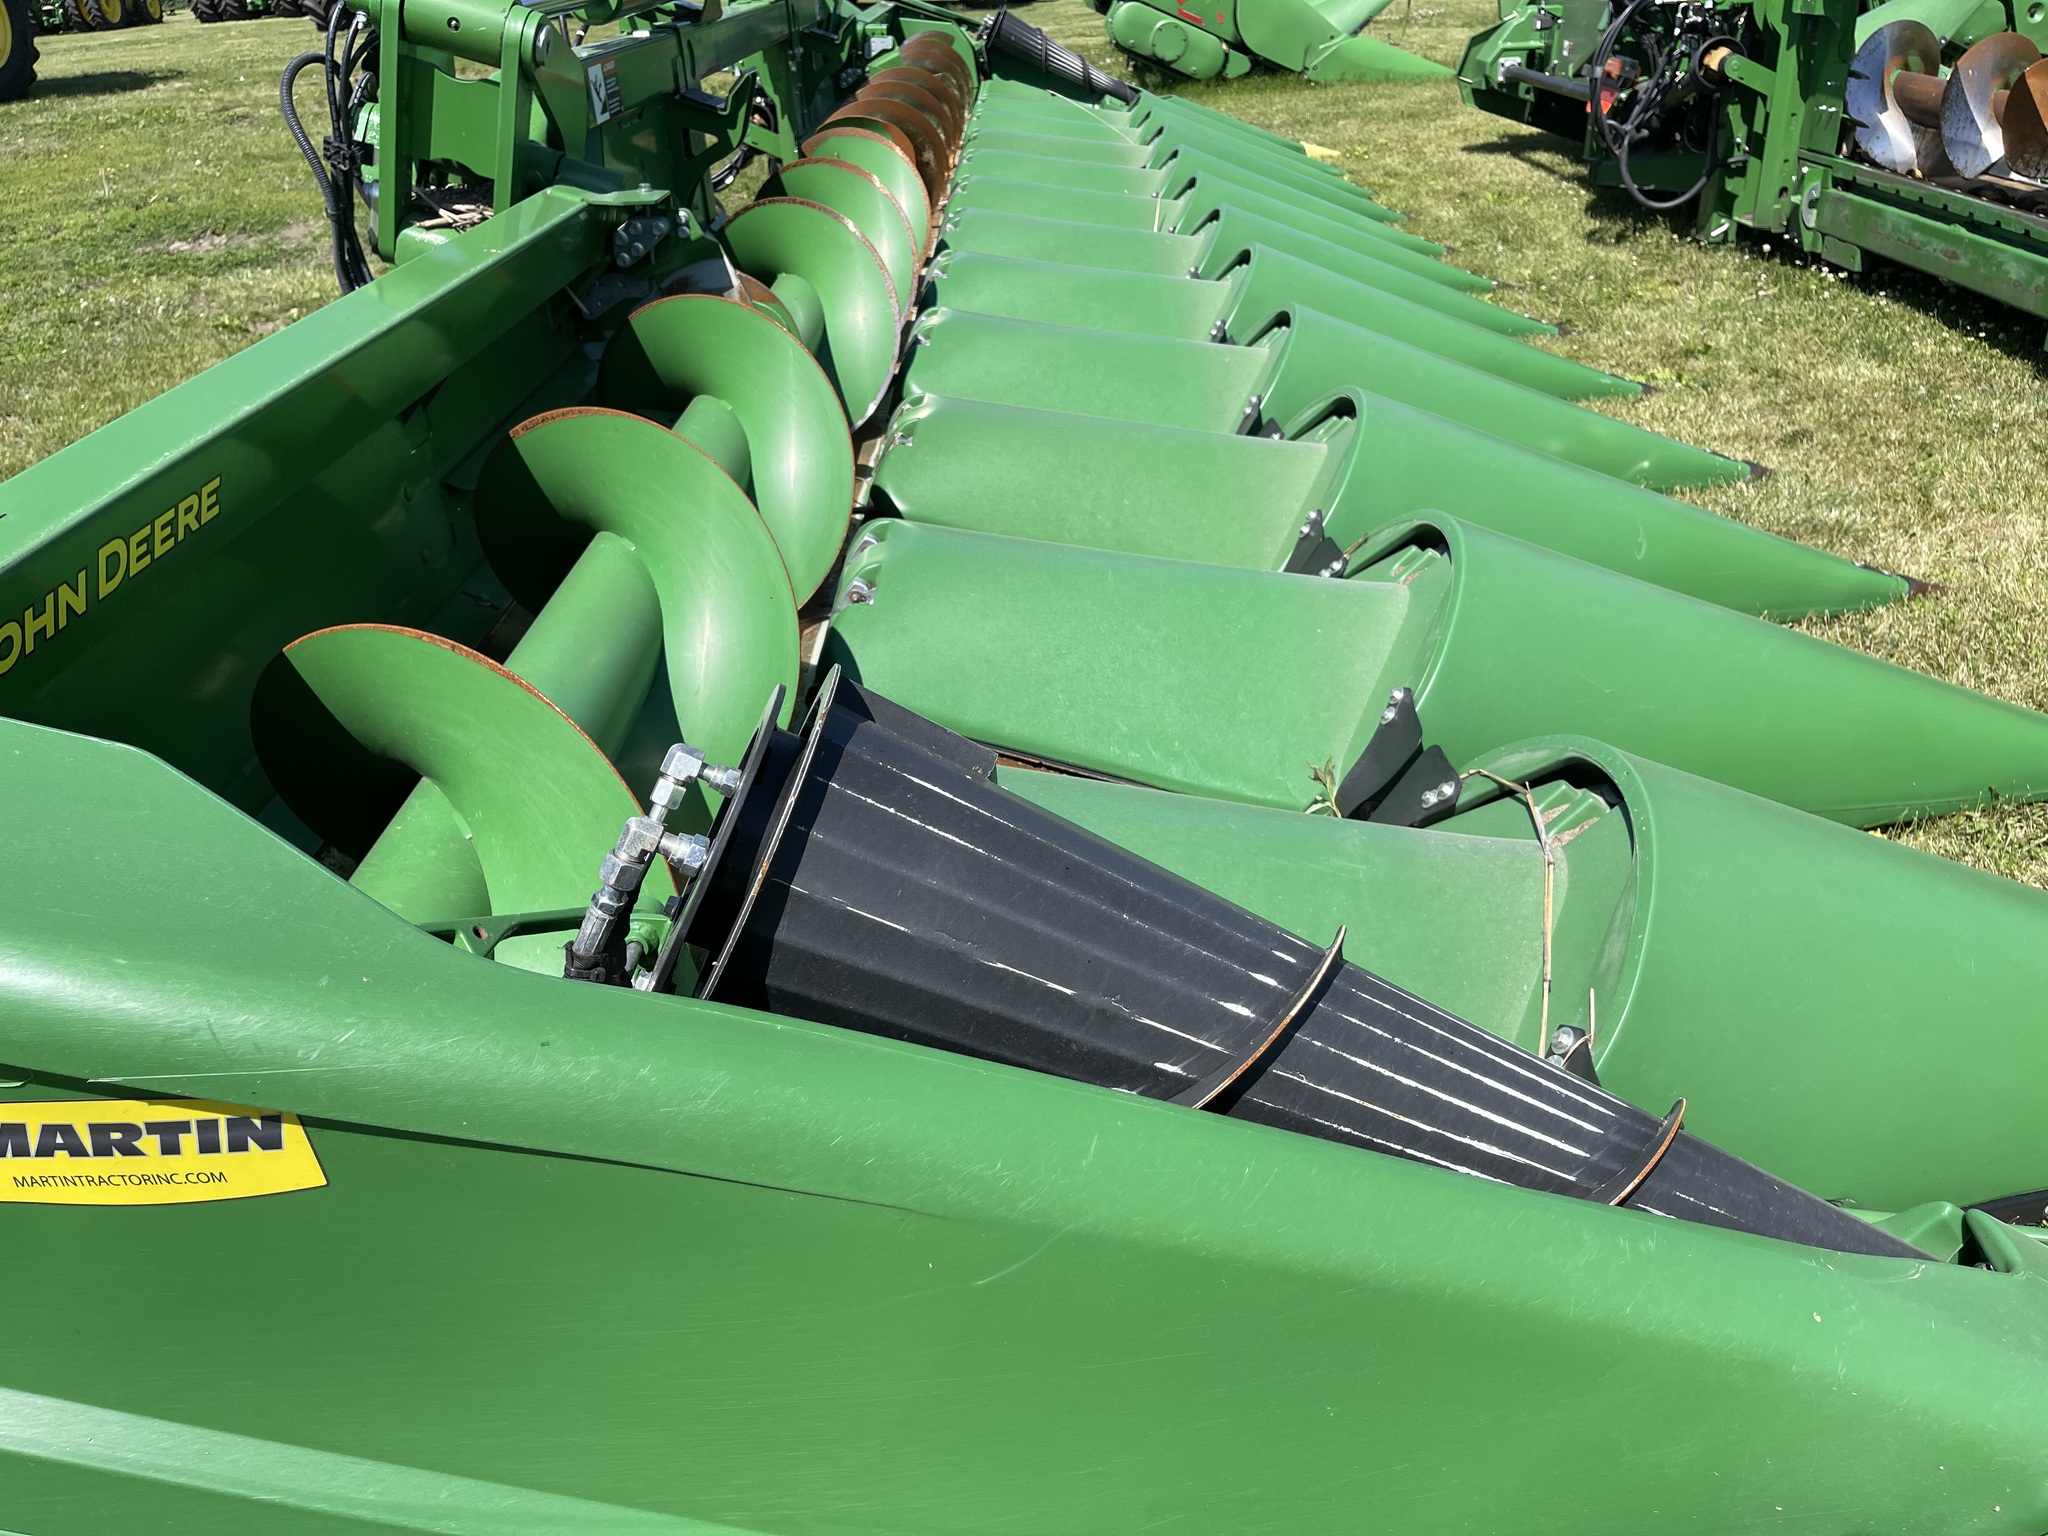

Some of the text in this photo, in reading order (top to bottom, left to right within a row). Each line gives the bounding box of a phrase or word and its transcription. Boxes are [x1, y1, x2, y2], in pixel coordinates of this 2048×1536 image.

[0, 475, 221, 675] OHN DEERE
[12, 1171, 228, 1188] MARTINTRACTORINC.COM
